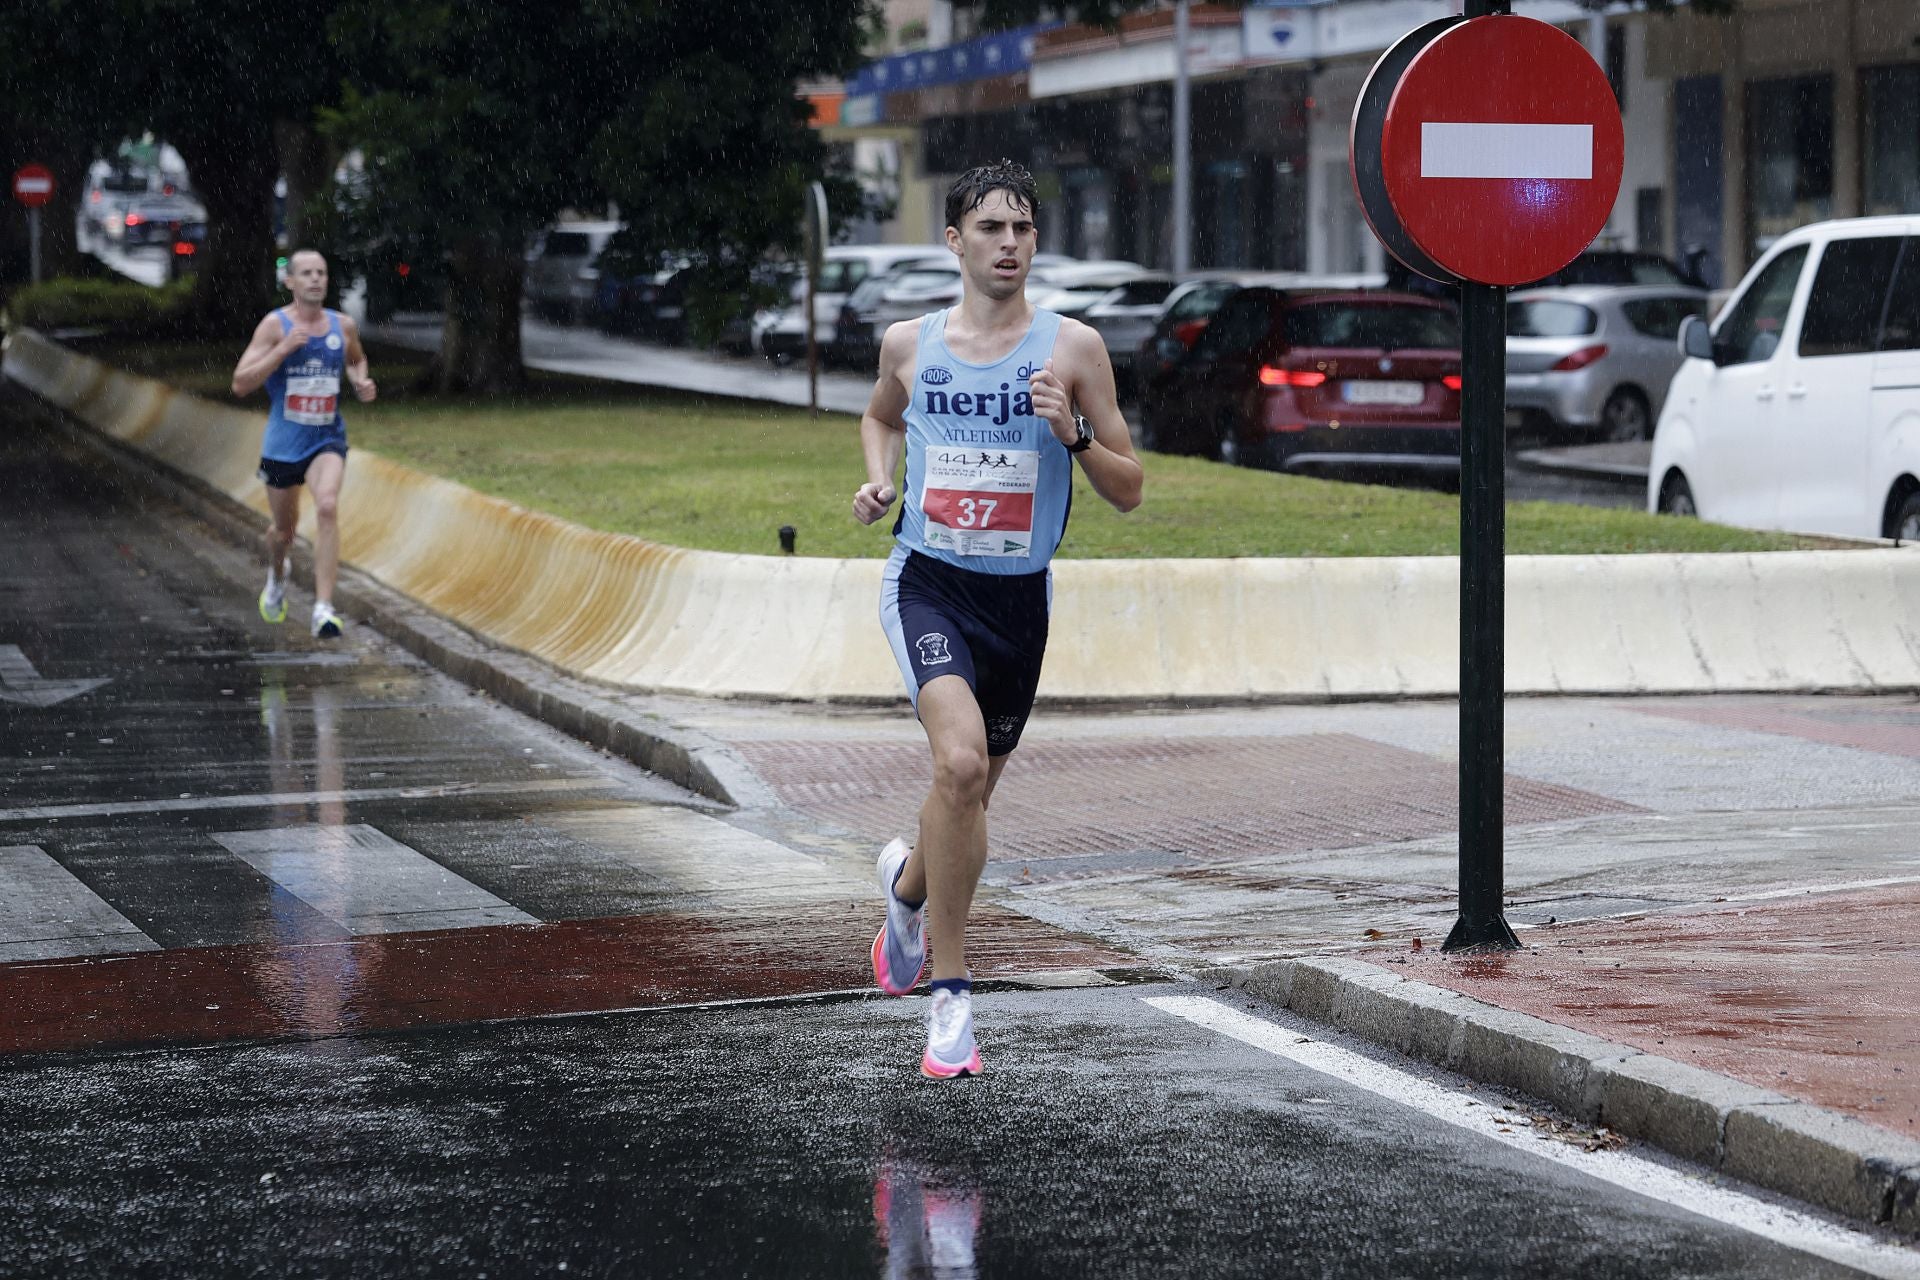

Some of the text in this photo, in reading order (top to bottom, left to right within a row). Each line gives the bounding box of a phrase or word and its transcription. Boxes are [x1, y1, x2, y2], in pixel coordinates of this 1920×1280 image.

[922, 369, 952, 384] TROPS
[925, 382, 1034, 425] nerja
[943, 427, 1022, 443] ATLETISMO
[938, 452, 966, 465] 44
[956, 497, 997, 528] 37
